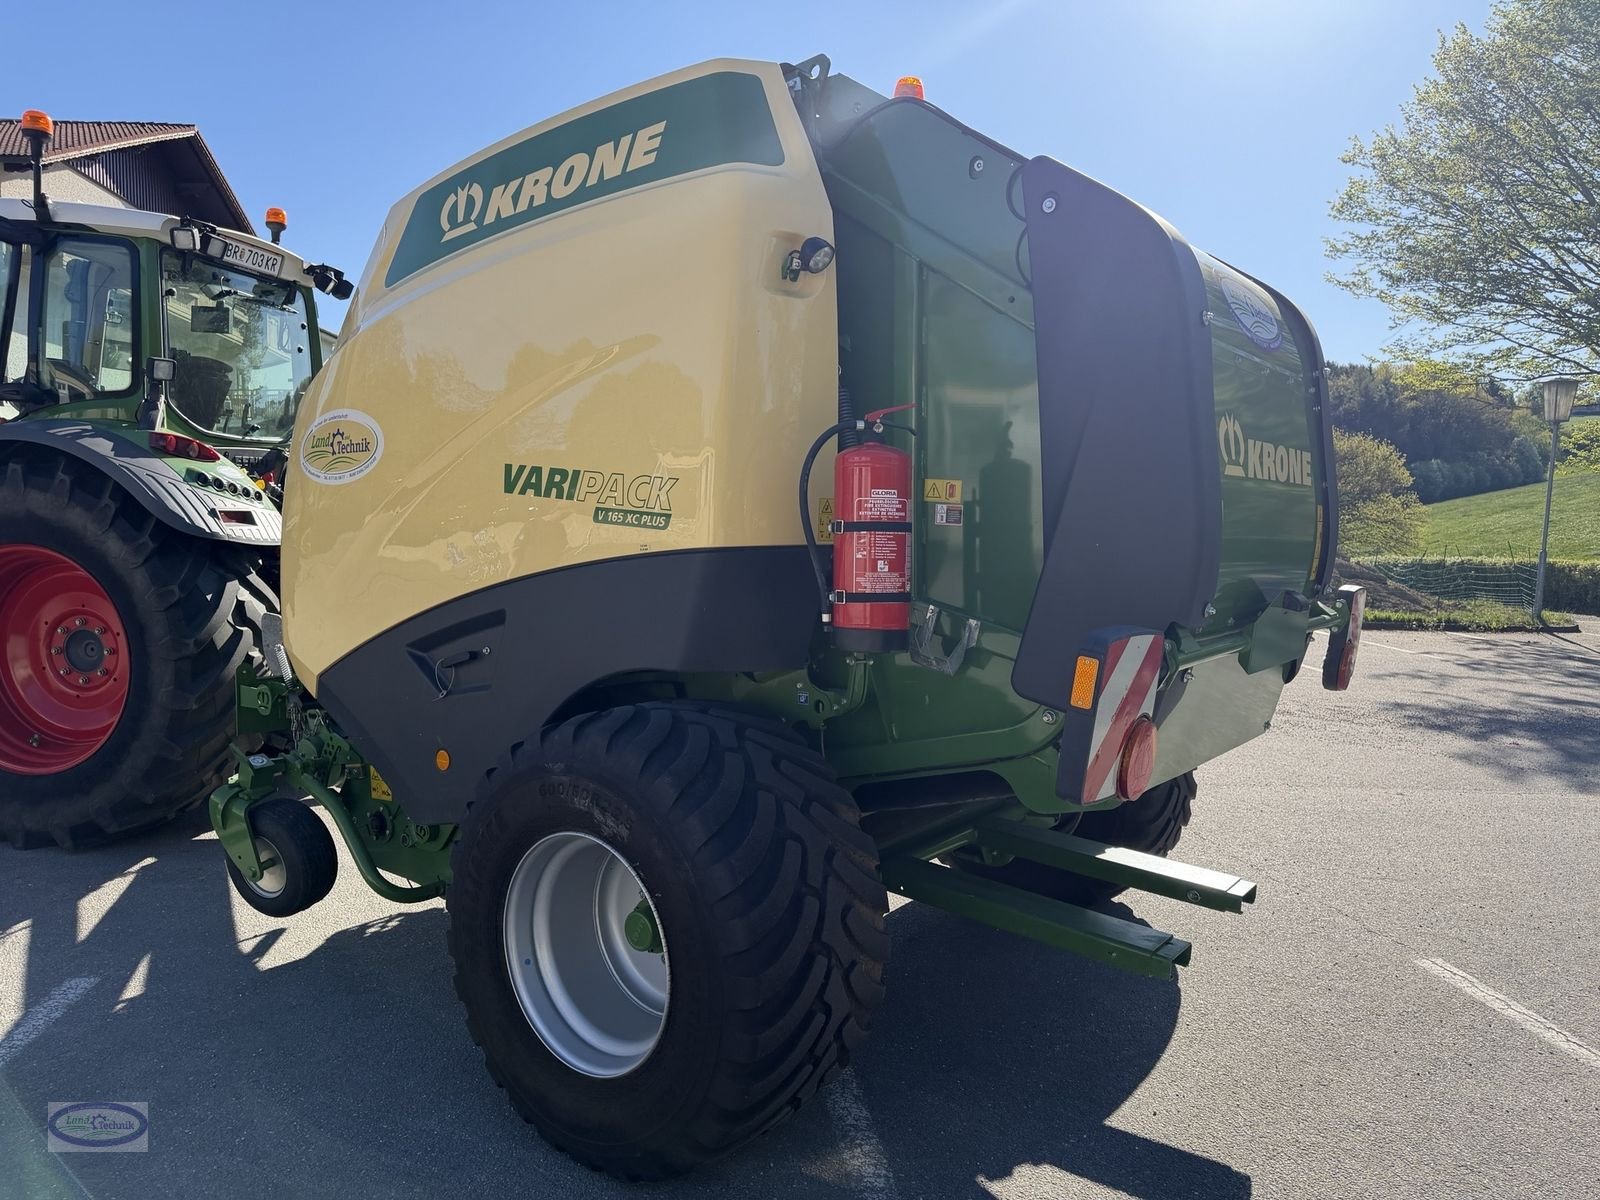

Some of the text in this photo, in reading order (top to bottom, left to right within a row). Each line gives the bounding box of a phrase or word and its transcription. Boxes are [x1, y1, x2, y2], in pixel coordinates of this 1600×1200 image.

[483, 120, 667, 225] KRONE
[225, 242, 240, 260] BR
[310, 432, 371, 455] Land Technik
[1247, 438, 1312, 486] KRONE
[503, 463, 680, 511] VARIPACK
[598, 510, 666, 527] V 165 XC PLUS
